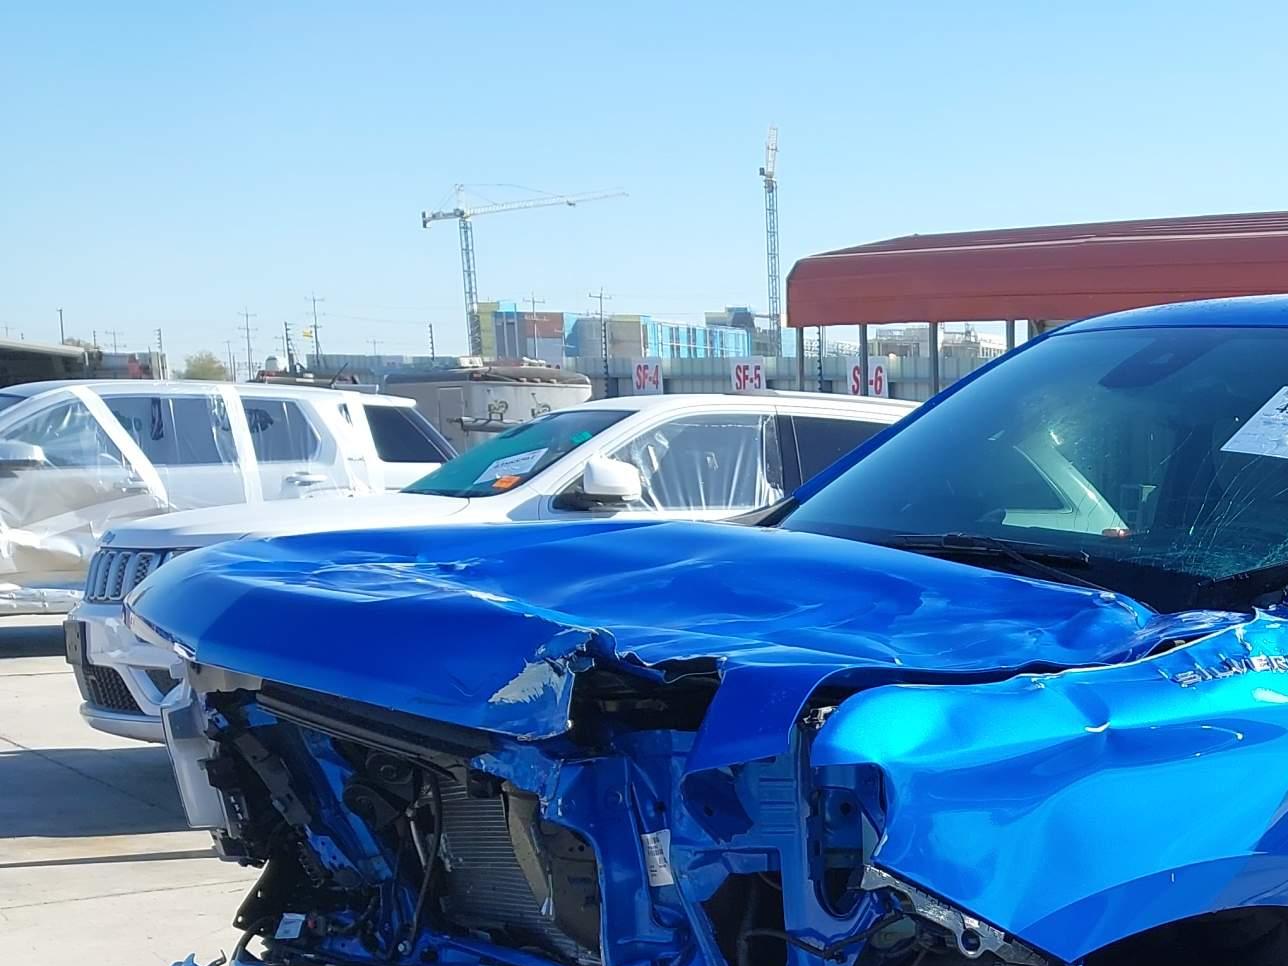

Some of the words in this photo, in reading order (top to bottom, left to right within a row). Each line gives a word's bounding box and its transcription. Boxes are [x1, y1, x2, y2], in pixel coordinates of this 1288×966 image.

[636, 364, 660, 390] SF-4
[735, 364, 761, 390] SF-5
[851, 365, 884, 395] S-6
